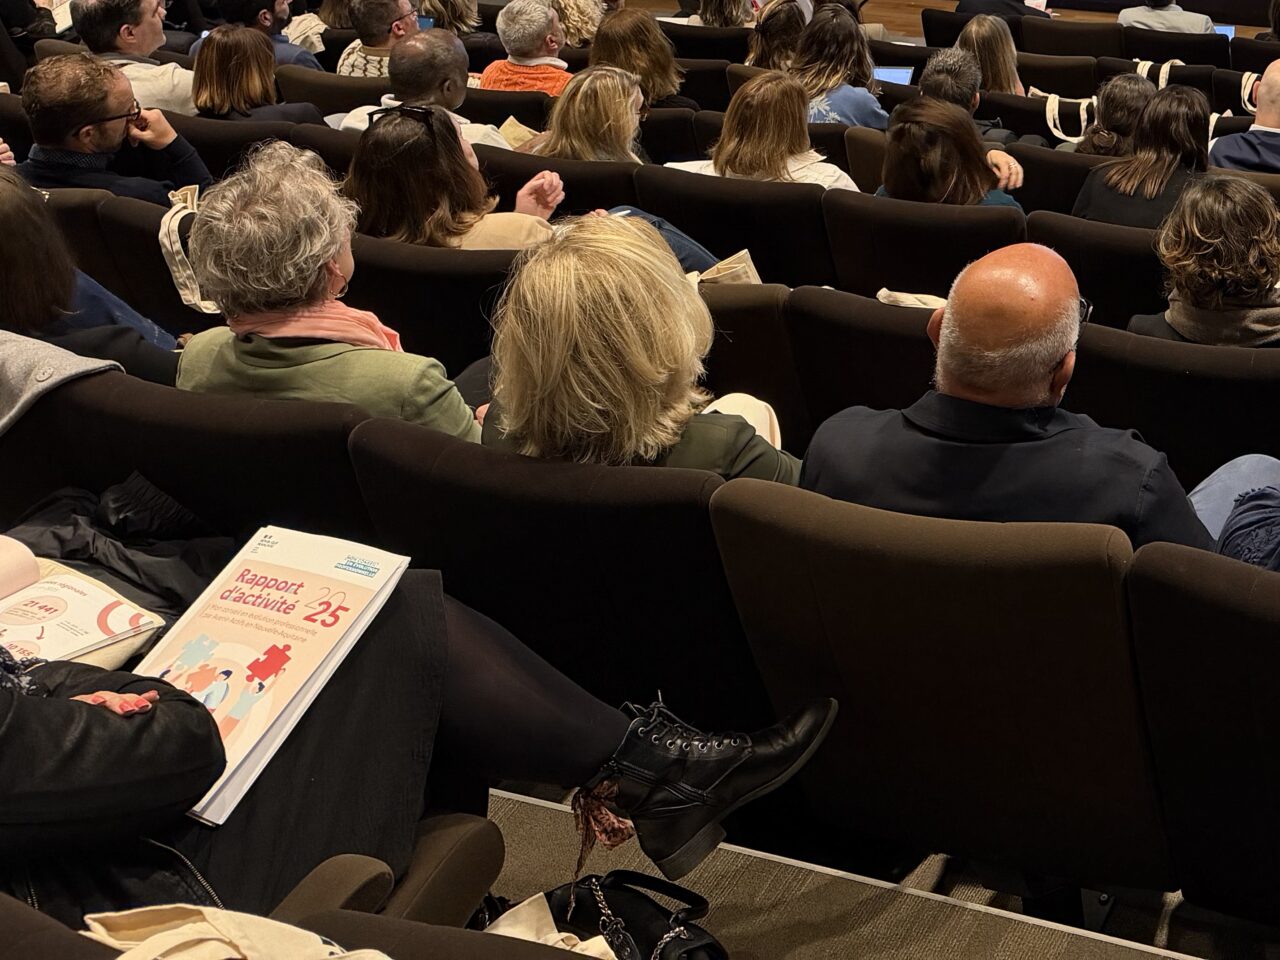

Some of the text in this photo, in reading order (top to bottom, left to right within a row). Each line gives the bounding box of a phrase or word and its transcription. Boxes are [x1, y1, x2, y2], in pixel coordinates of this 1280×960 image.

[235, 569, 304, 595] Rapport
[220, 586, 300, 615] d'activité
[303, 600, 351, 628] 25
